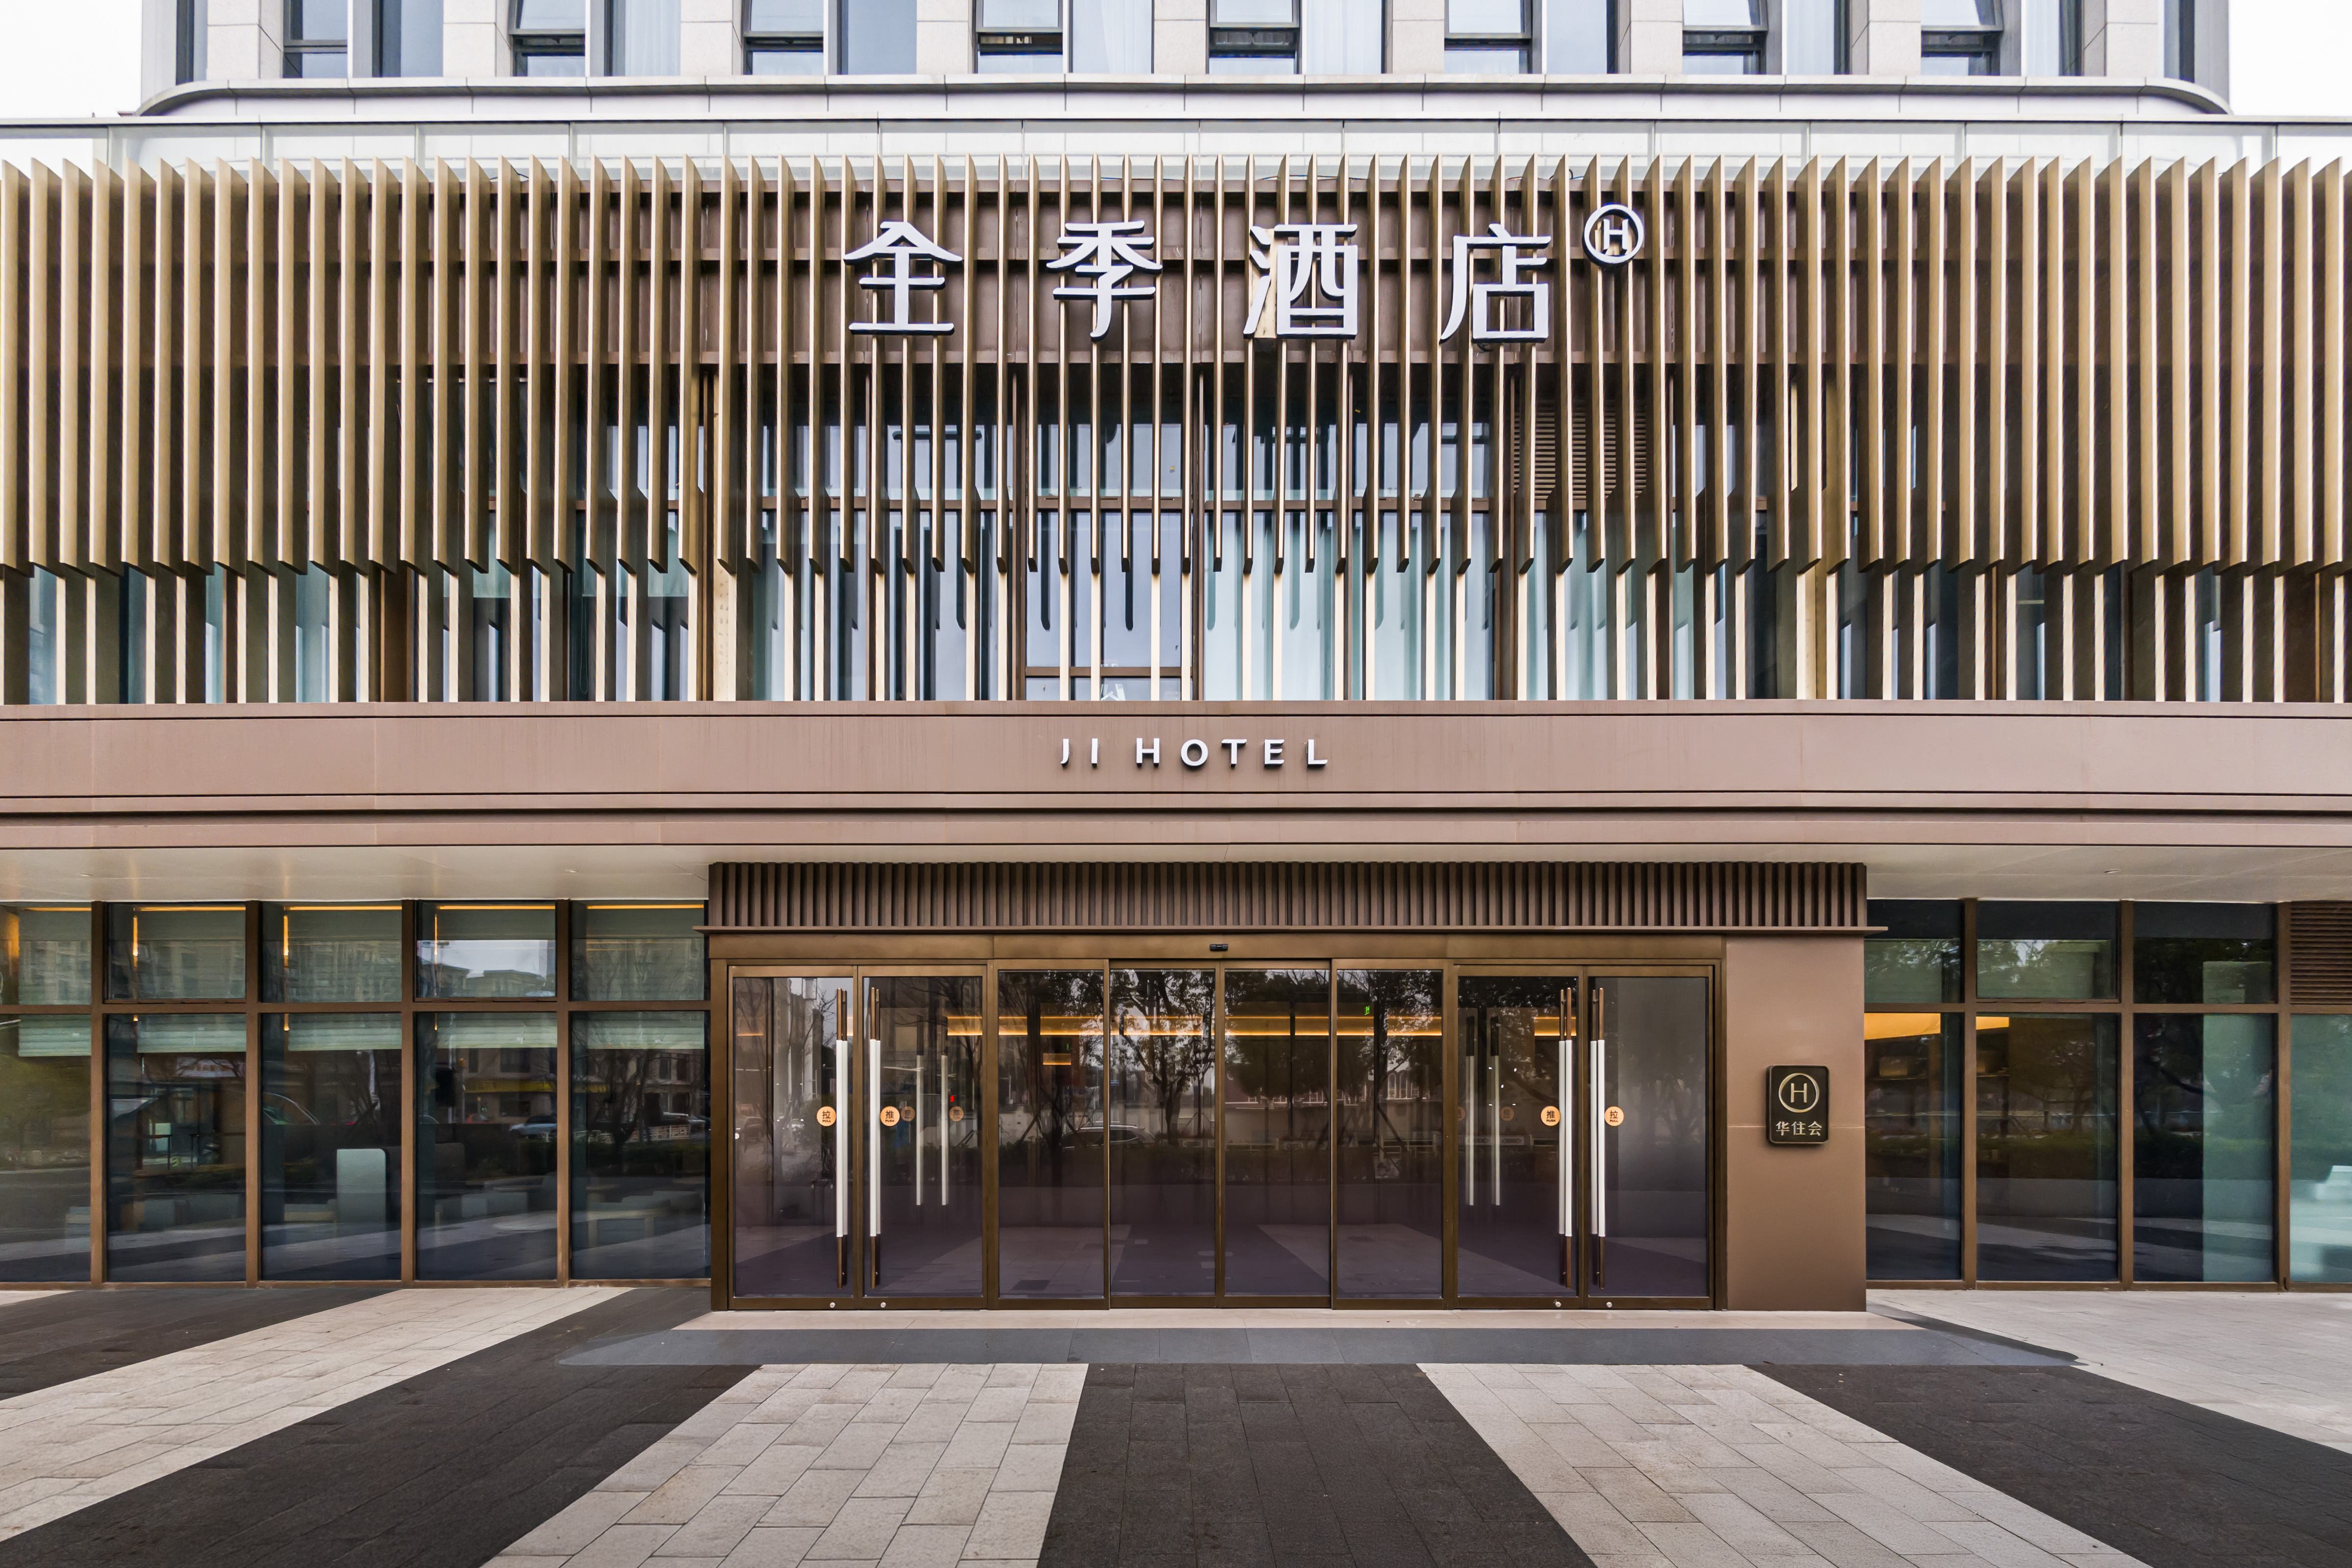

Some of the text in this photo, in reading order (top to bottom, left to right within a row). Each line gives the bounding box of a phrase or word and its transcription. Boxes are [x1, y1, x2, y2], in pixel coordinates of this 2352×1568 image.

[843, 221, 1551, 342] 全季酒店
[1060, 738, 1328, 766] JI HOTEL
[822, 1110, 831, 1119] 拉
[885, 1110, 894, 1119] 推
[1546, 1110, 1555, 1119] 推
[1610, 1110, 1618, 1119] 拉
[1776, 1121, 1822, 1136] 华住会
